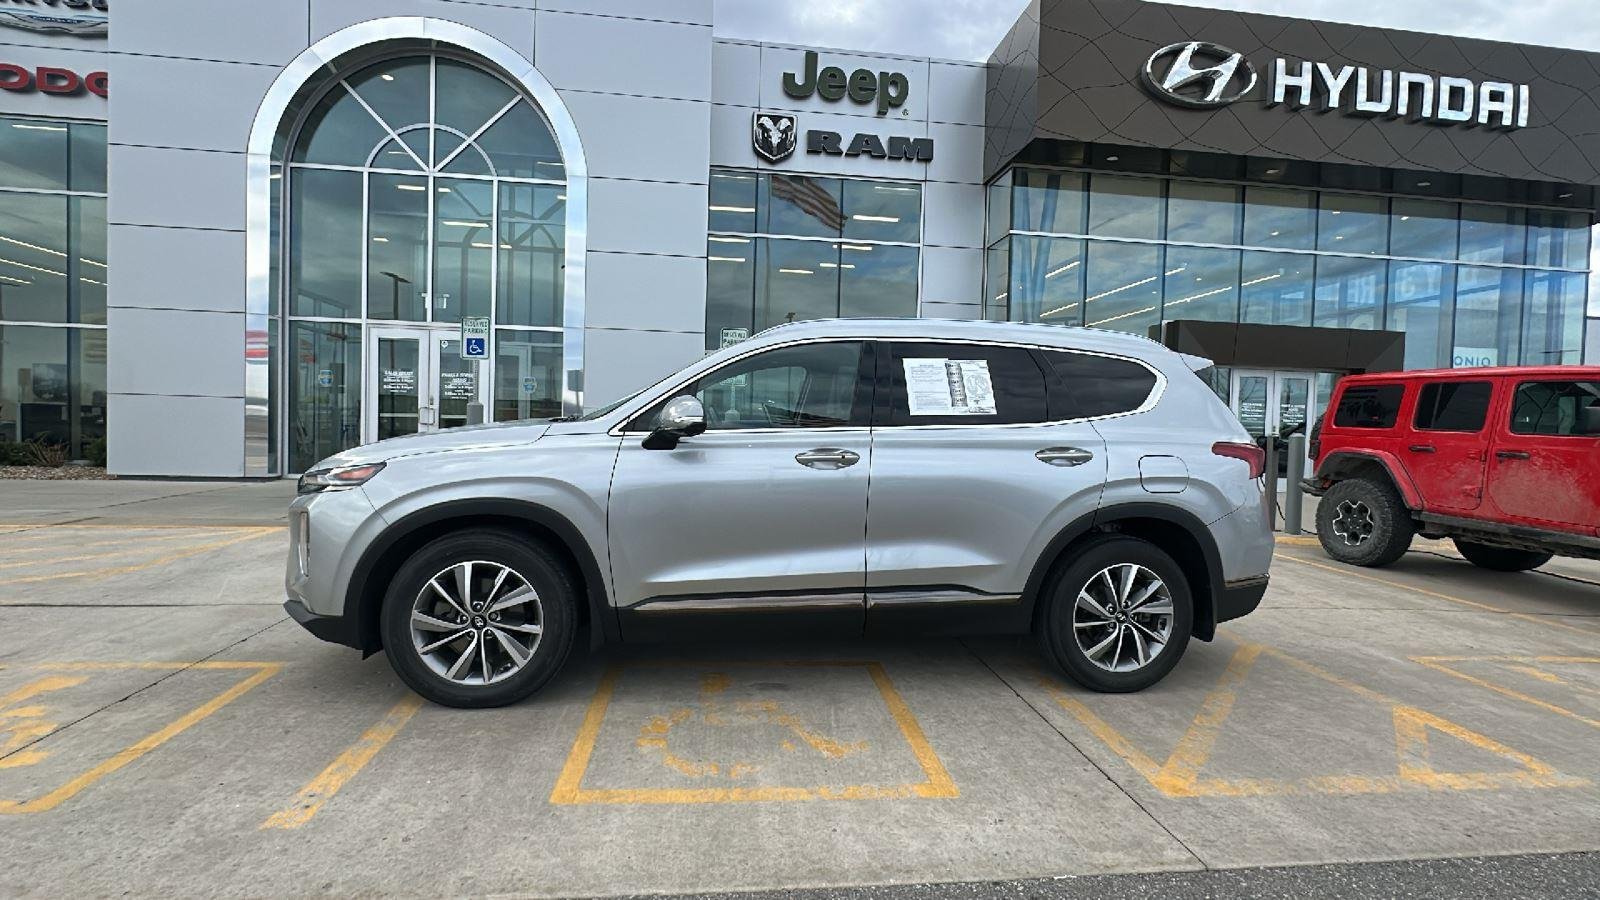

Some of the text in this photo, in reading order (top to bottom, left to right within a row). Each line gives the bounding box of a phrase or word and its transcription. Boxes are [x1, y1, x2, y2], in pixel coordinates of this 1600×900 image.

[782, 50, 909, 116] Jeep
[1272, 57, 1530, 128] HYUNDAI
[806, 129, 934, 162] RAM
